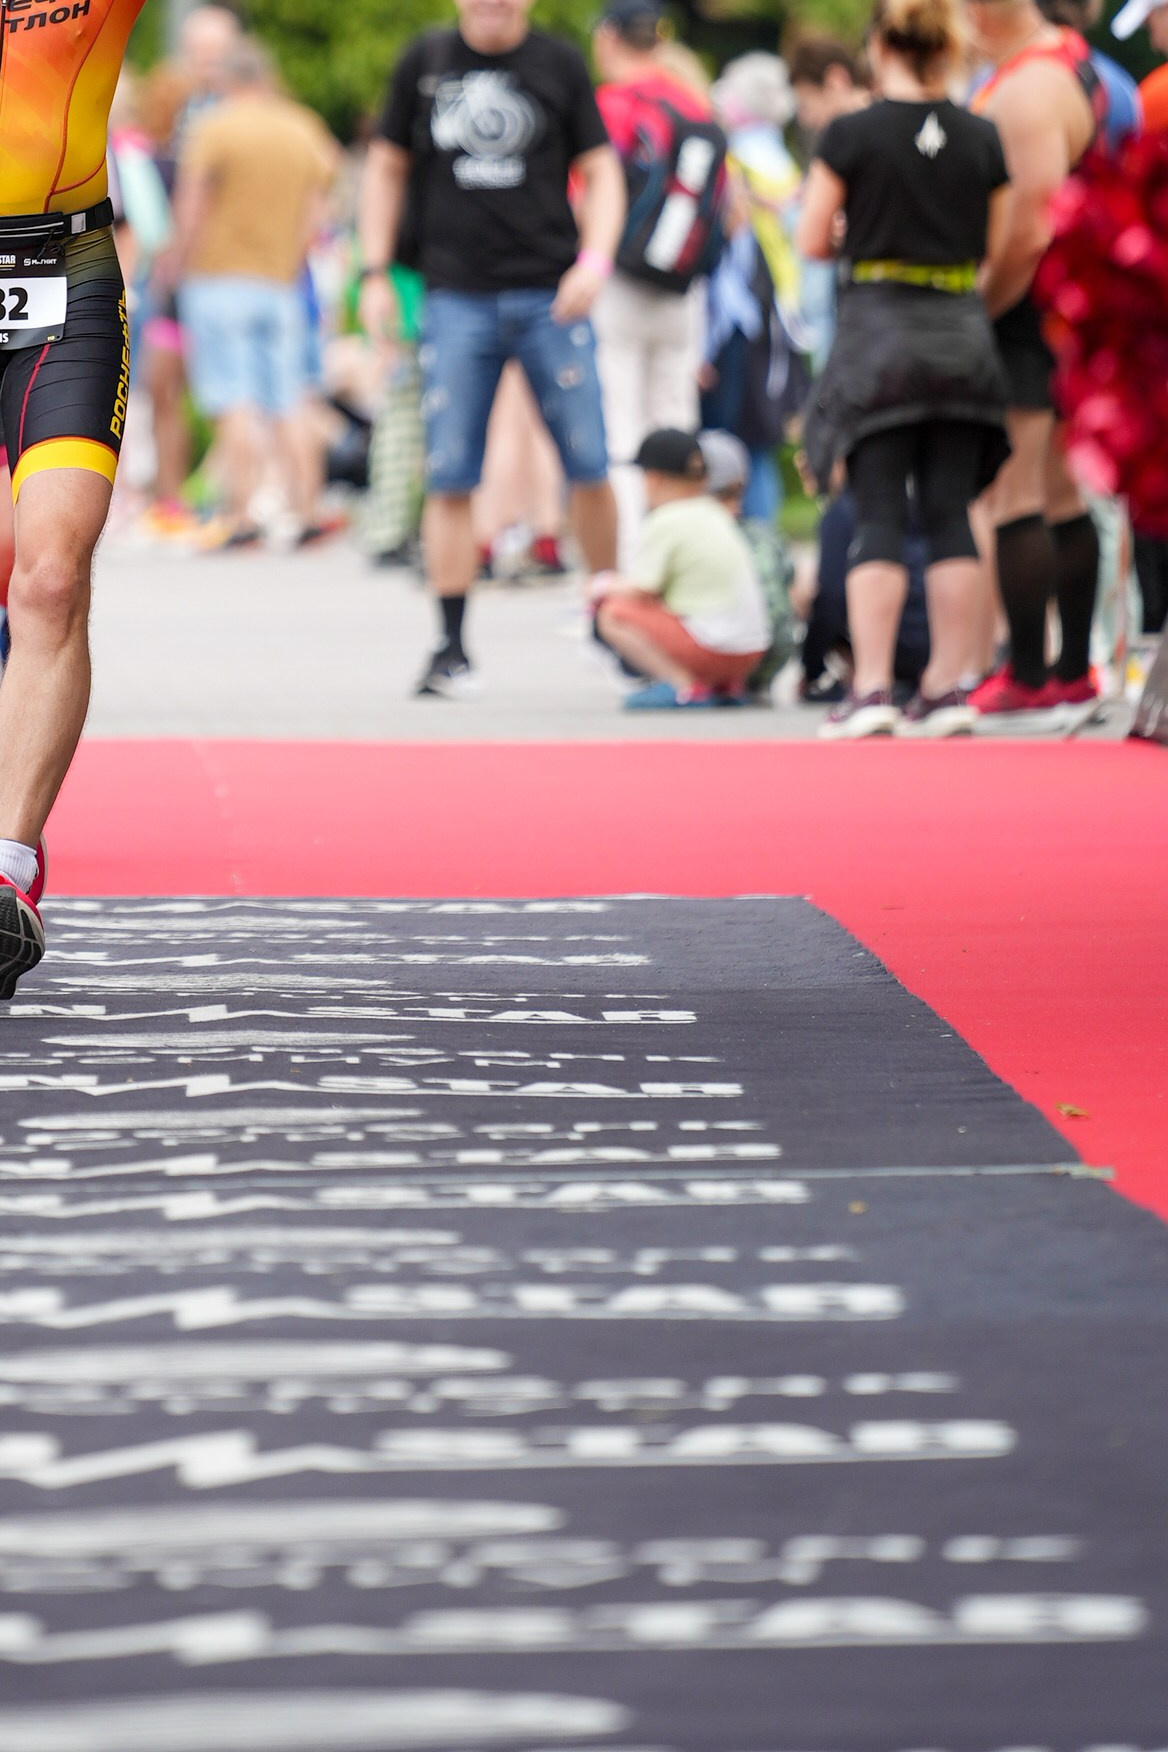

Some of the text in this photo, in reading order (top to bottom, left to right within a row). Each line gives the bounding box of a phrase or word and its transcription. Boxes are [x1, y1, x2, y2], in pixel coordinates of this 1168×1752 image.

[306, 1006, 698, 1021] STAR
[317, 1075, 744, 1095] STAR
[311, 1143, 780, 1166] STAR
[313, 1180, 808, 1205] STAR
